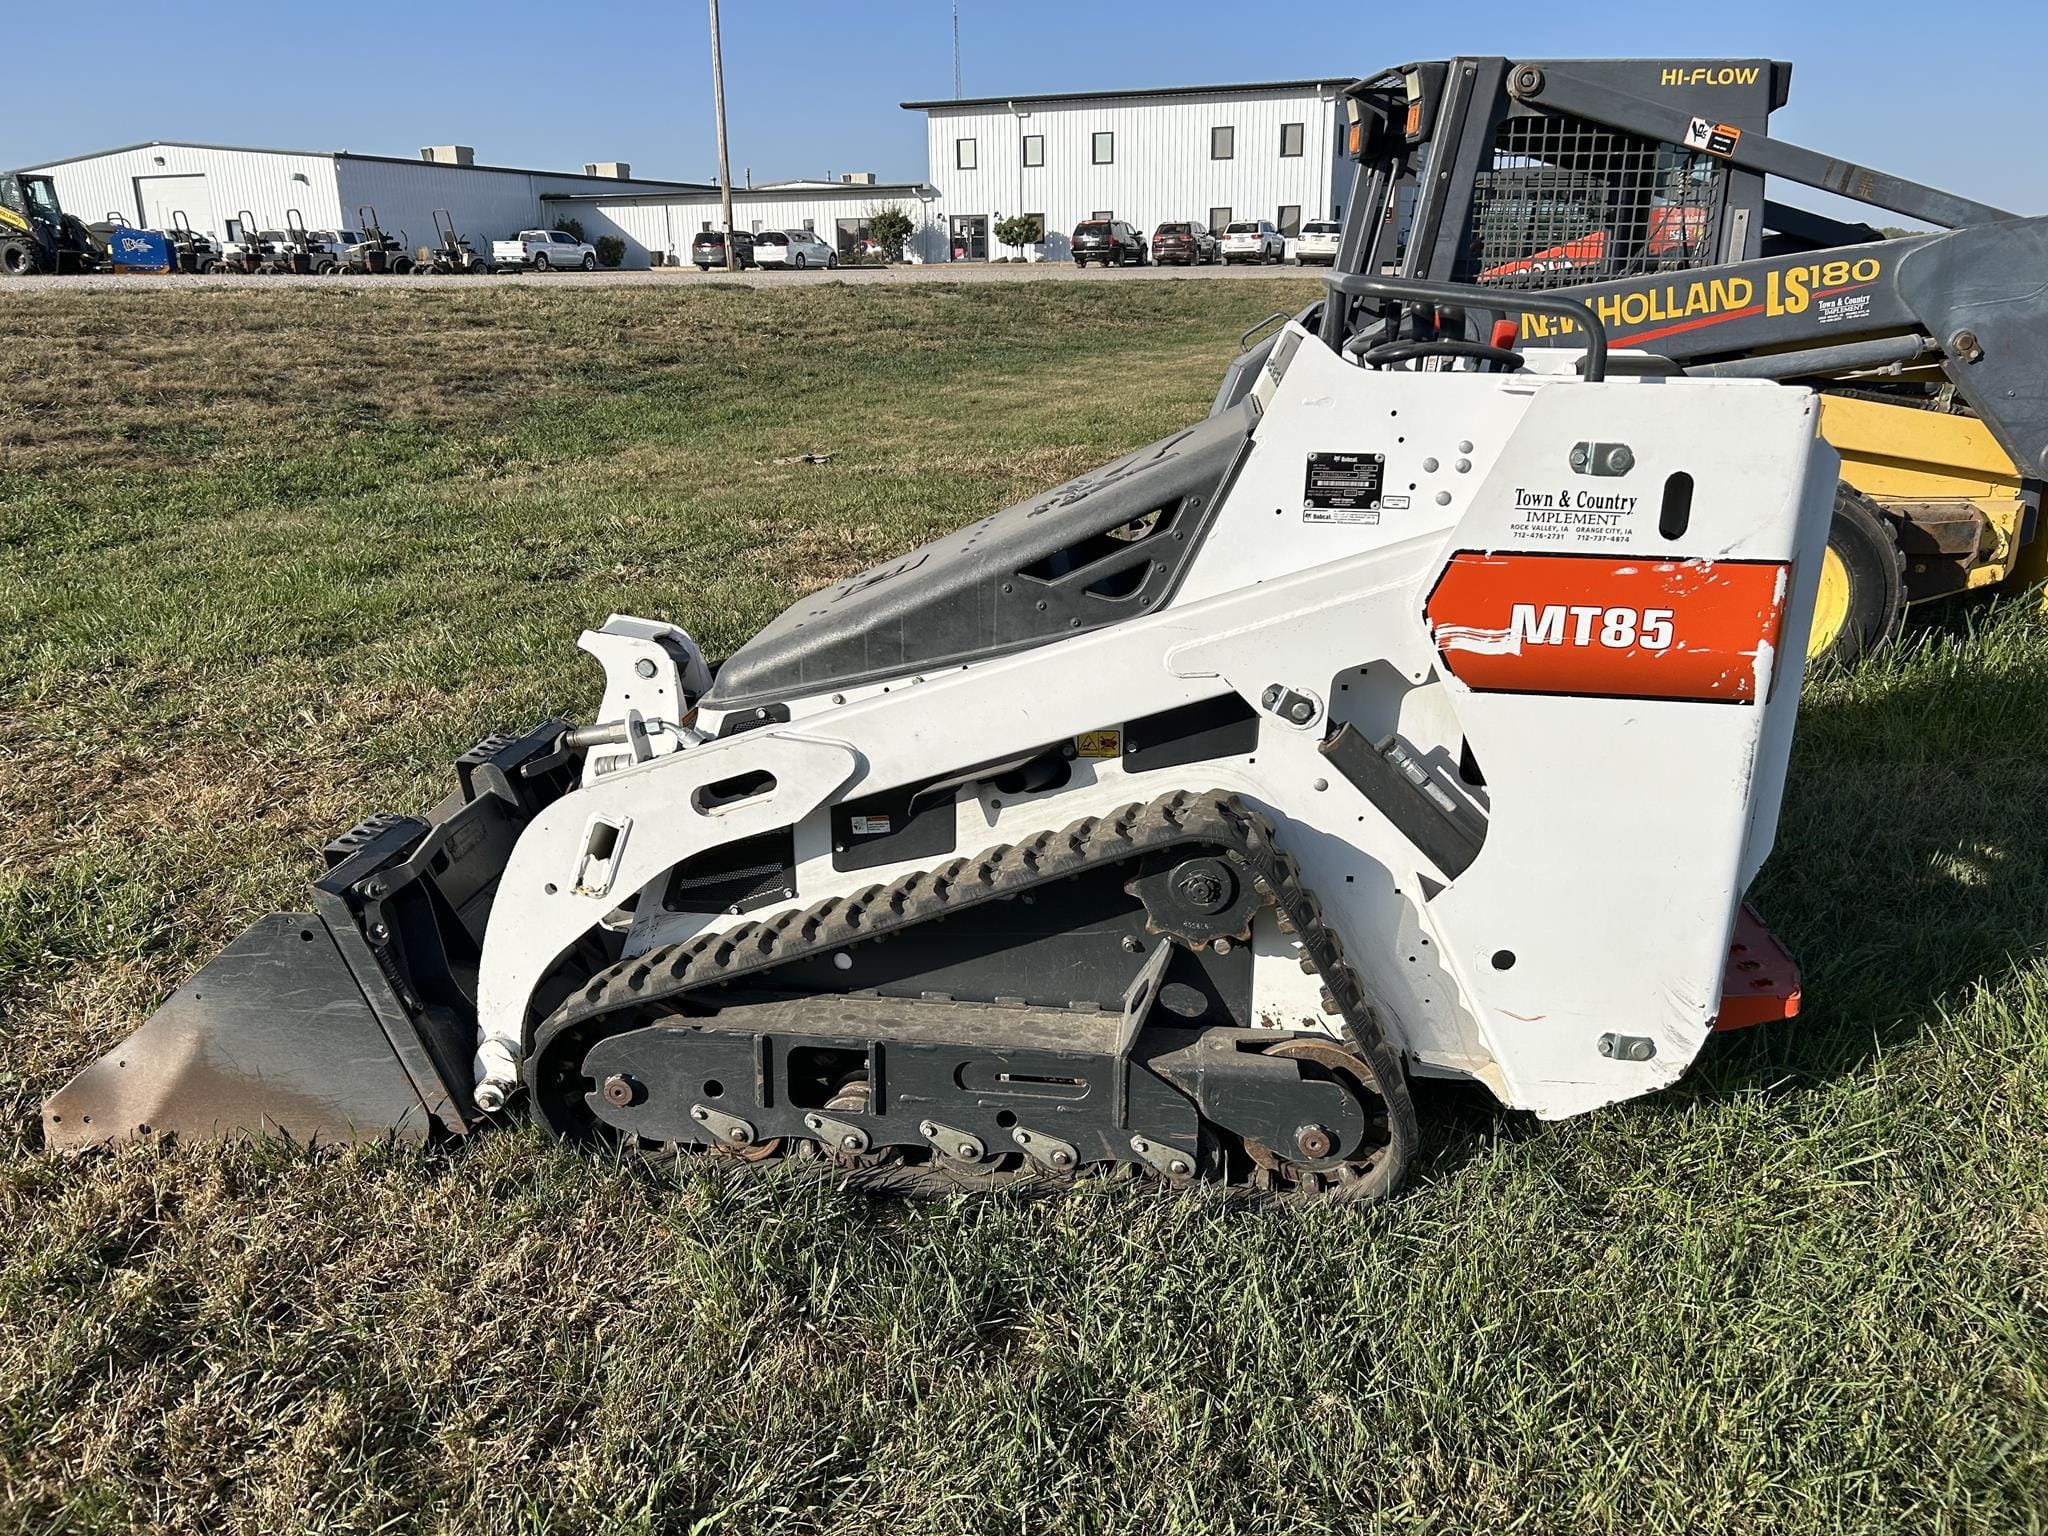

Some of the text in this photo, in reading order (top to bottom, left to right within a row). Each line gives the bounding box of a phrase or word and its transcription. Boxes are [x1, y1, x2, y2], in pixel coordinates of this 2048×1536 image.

[1661, 68, 1759, 86] HI-FLOW
[1599, 277, 1753, 326] HOLLAND
[1819, 301, 1836, 309] Town
[1844, 295, 1870, 304] Country
[1515, 488, 1637, 515] Town & Country
[1526, 511, 1621, 526] IMPLEMENT
[1575, 526, 1603, 534] ORANGE
[1511, 603, 1674, 650] MT85
